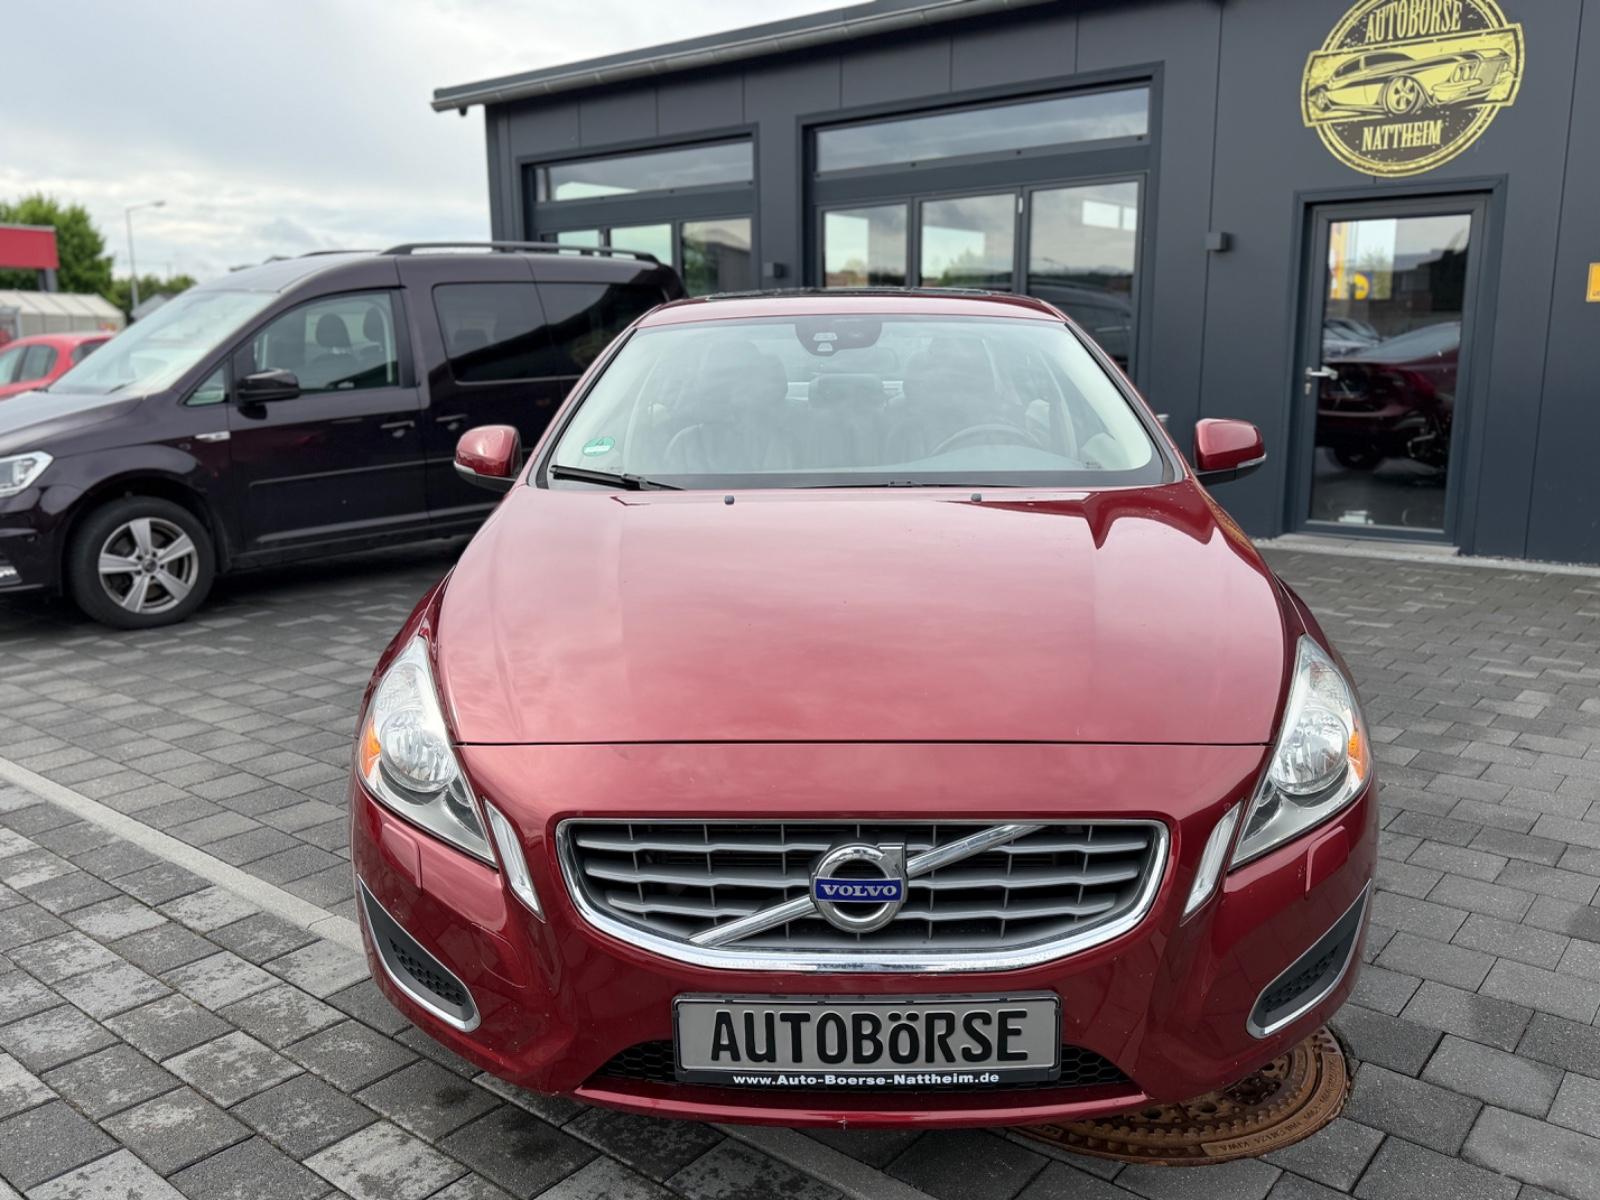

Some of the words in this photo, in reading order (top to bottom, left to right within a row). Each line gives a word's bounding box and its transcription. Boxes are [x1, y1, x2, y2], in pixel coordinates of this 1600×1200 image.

[1361, 119, 1443, 151] NATTHEIM
[820, 884, 897, 896] VOLVO
[710, 1009, 1028, 1064] AUTOBÖRSE
[732, 1072, 1000, 1086] www.Auto-Boerse-Nattheim.de
